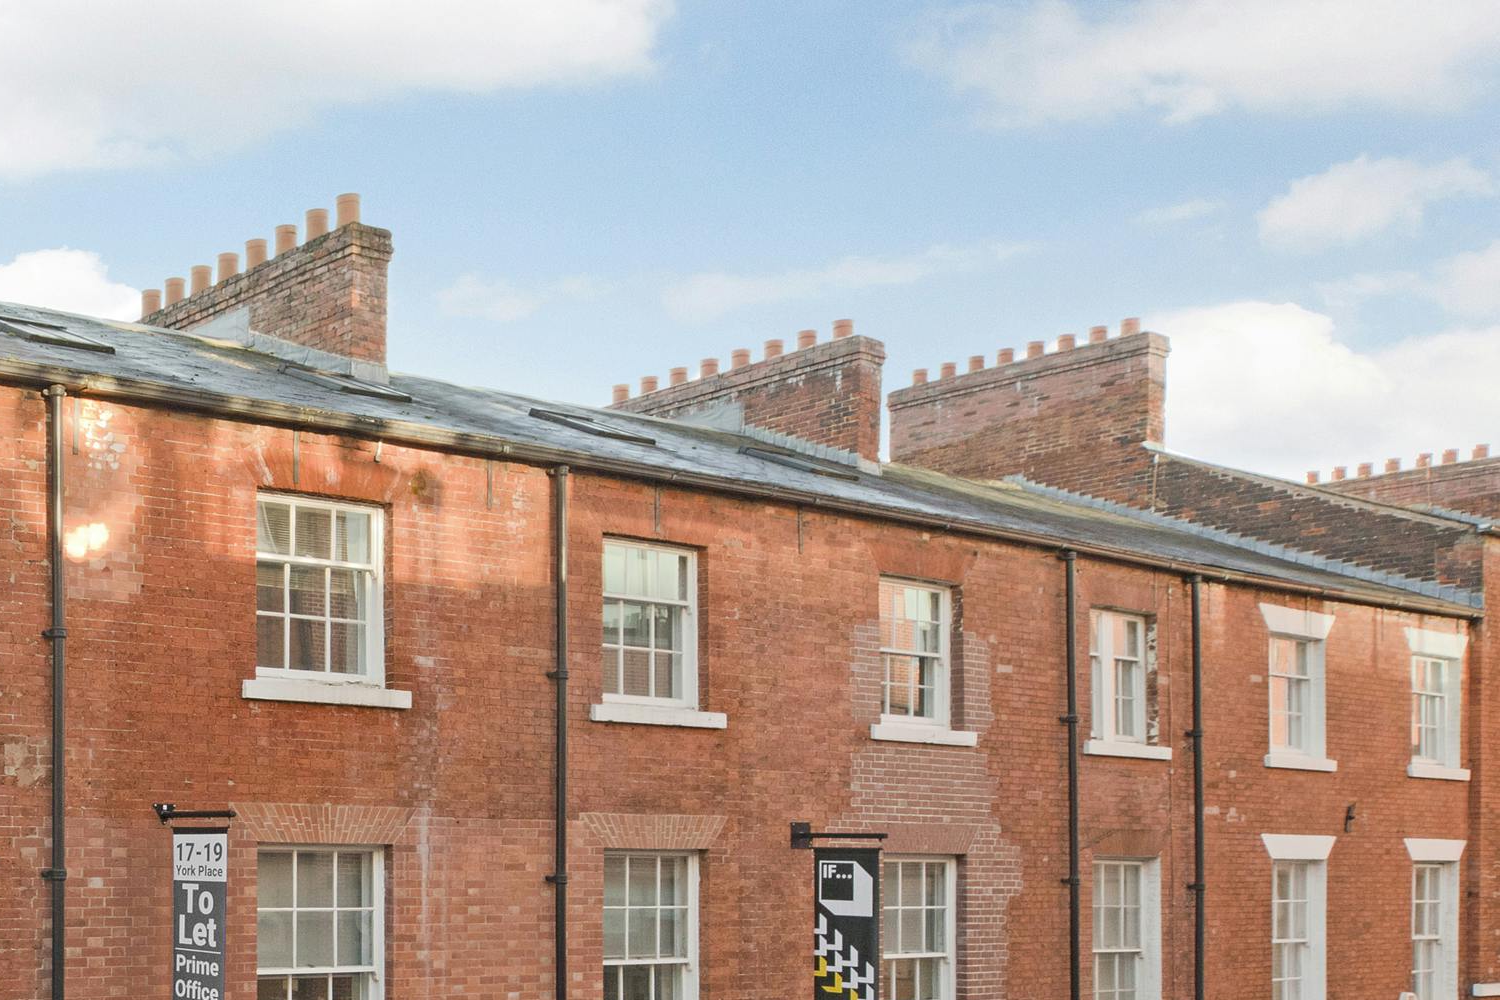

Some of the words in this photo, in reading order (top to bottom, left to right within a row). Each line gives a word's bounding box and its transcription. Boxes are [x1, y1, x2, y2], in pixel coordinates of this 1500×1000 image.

[176, 842, 223, 862] 17-19
[175, 864, 196, 876] York
[198, 864, 223, 877] Place
[182, 882, 214, 915] To
[178, 914, 217, 948] Let
[176, 953, 220, 977] Prime
